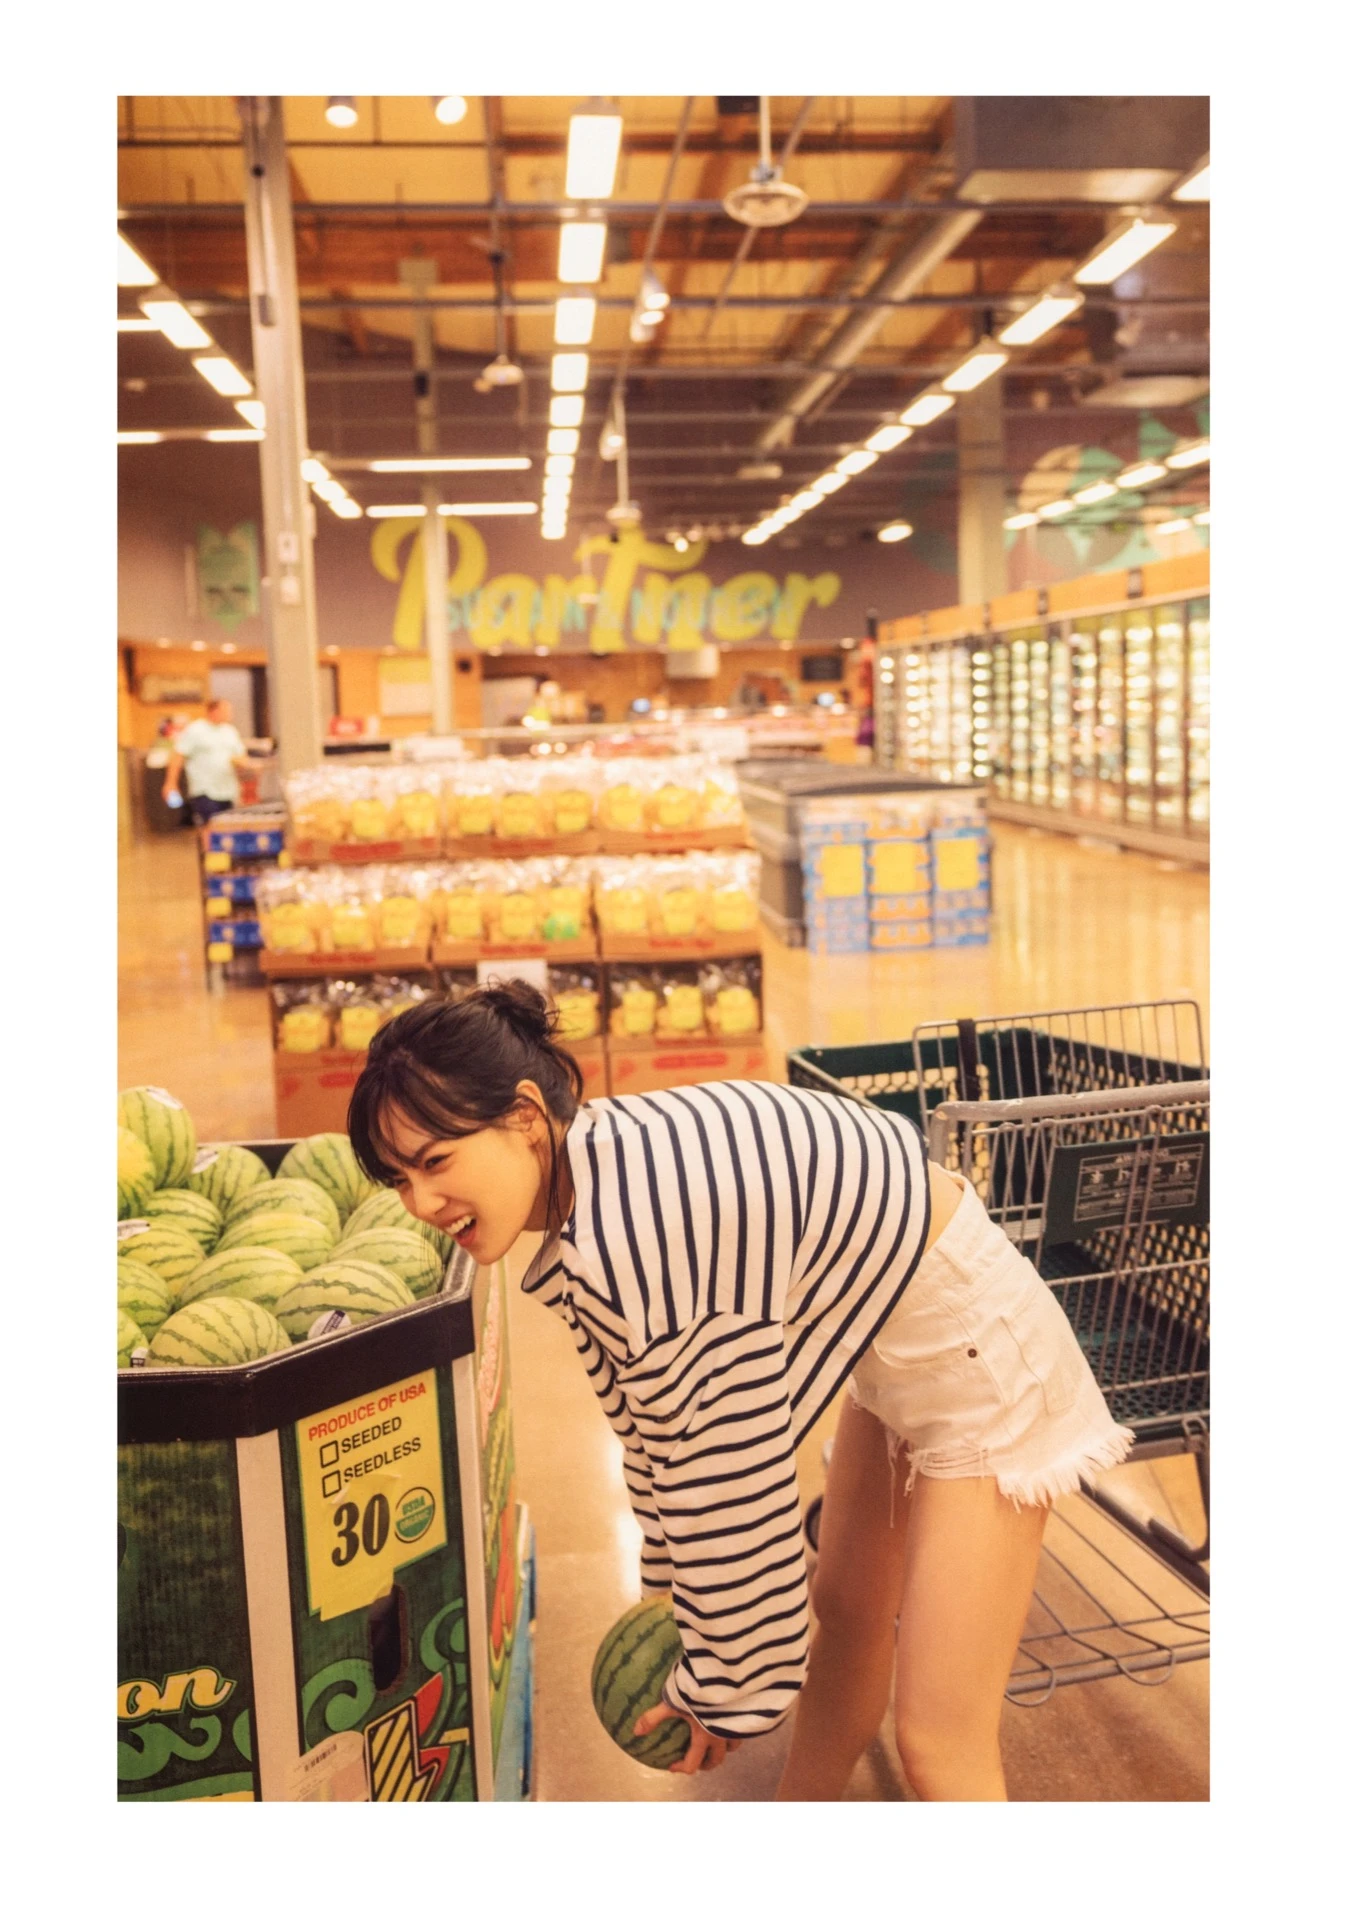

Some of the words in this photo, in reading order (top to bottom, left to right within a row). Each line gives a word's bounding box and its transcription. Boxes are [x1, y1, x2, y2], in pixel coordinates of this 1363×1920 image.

[308, 1402, 376, 1441] PRODUCE
[378, 1394, 397, 1411] OF
[399, 1382, 426, 1403] USA
[341, 1416, 402, 1453] SEEDED
[343, 1437, 421, 1482] SEEDLESS
[402, 1495, 425, 1516] USDA
[331, 1493, 390, 1567] 30
